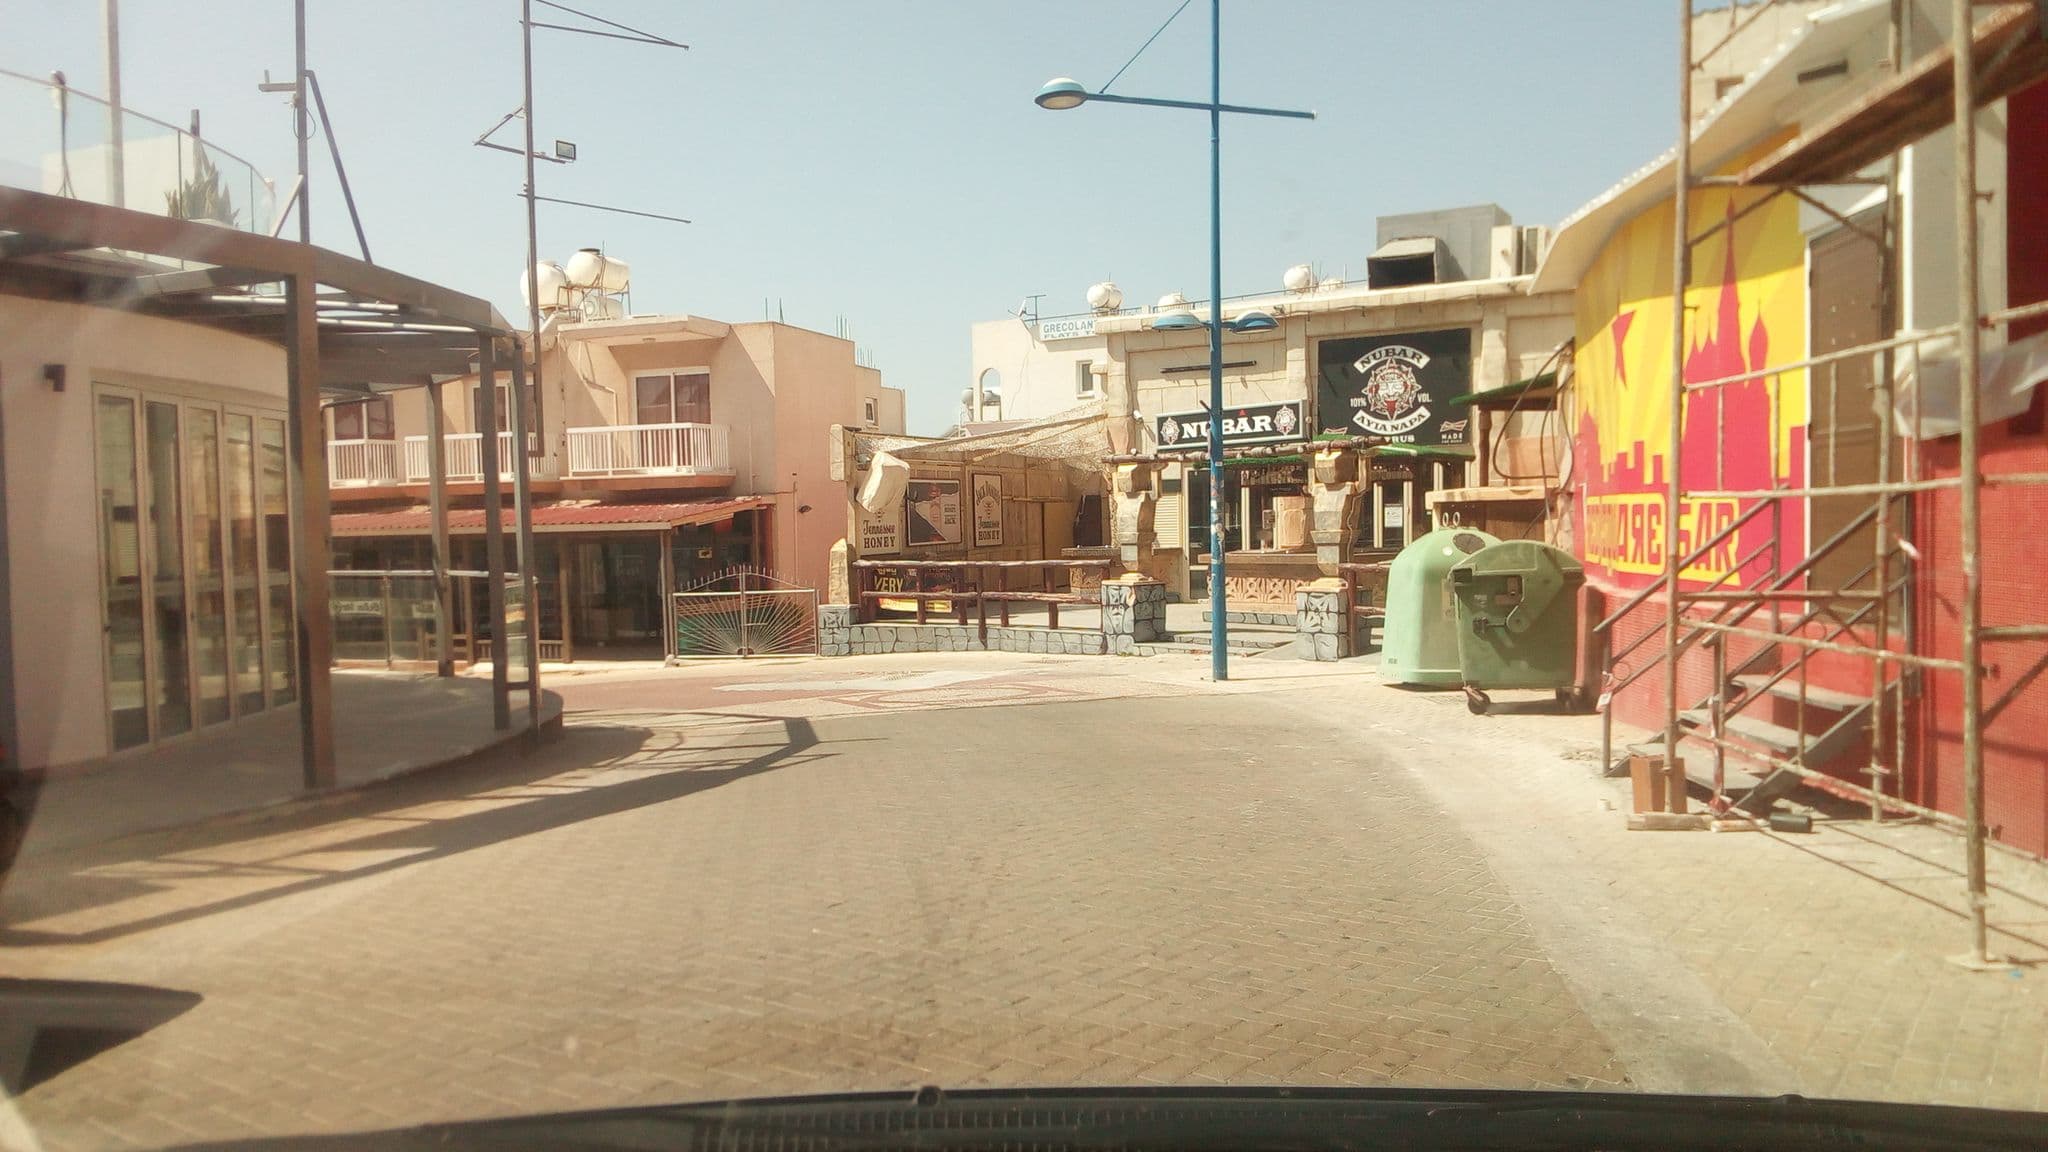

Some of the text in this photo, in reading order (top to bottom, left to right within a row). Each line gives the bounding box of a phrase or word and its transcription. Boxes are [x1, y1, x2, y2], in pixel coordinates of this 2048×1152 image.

[1043, 319, 1097, 334] GRECOLAN
[1359, 348, 1425, 369] NUBAR
[1356, 415, 1388, 432] AYIA
[1390, 413, 1427, 432] NAPA
[863, 536, 896, 549] HONEY
